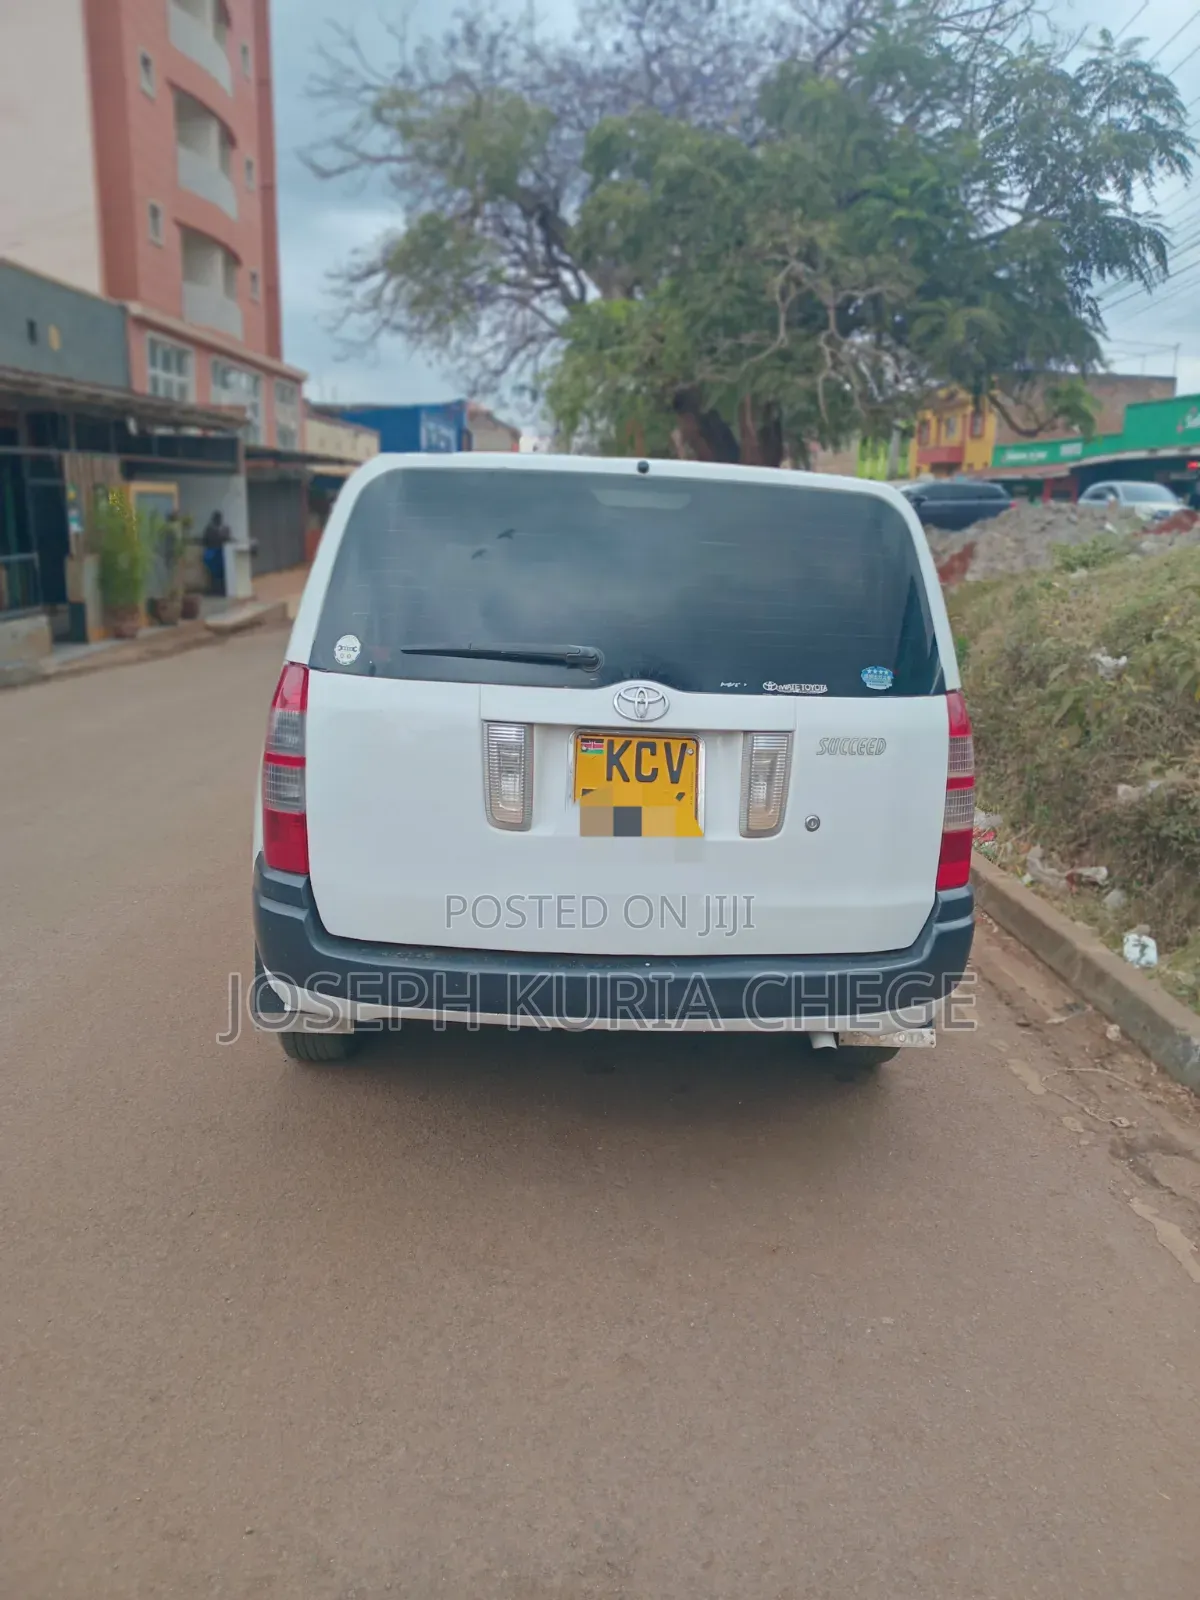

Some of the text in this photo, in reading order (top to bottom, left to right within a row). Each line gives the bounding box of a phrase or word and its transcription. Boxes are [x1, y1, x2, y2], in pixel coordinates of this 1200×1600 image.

[801, 684, 828, 692] TOYOTA
[816, 737, 887, 756] SUCCEED
[606, 739, 688, 784] KCV
